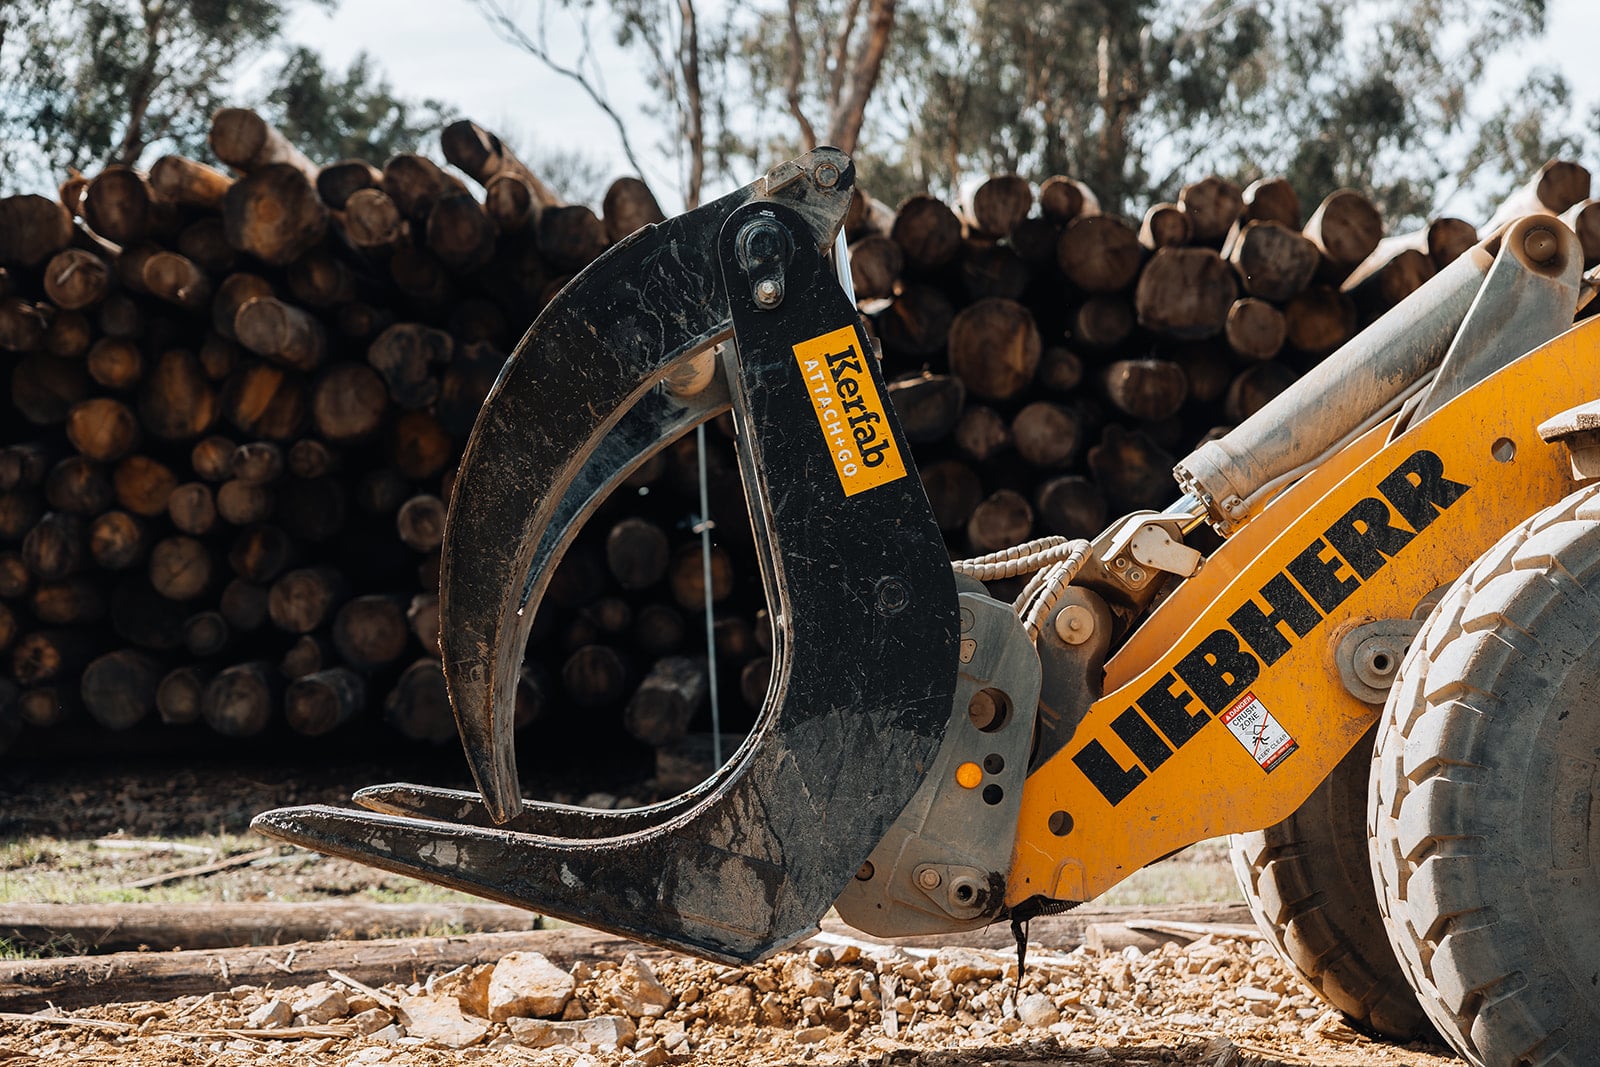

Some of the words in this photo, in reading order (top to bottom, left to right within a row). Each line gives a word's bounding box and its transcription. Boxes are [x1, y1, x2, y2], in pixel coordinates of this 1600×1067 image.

[804, 359, 858, 477] ATTACH+GO
[824, 345, 890, 468] Kerfab
[1071, 449, 1472, 807] LIEBHERR
[1229, 695, 1253, 717] DANGER
[1232, 703, 1257, 727] CRUSH
[1239, 711, 1260, 731] ZONE
[1257, 747, 1271, 761] KEEP
[1270, 733, 1287, 750] CLEAR
